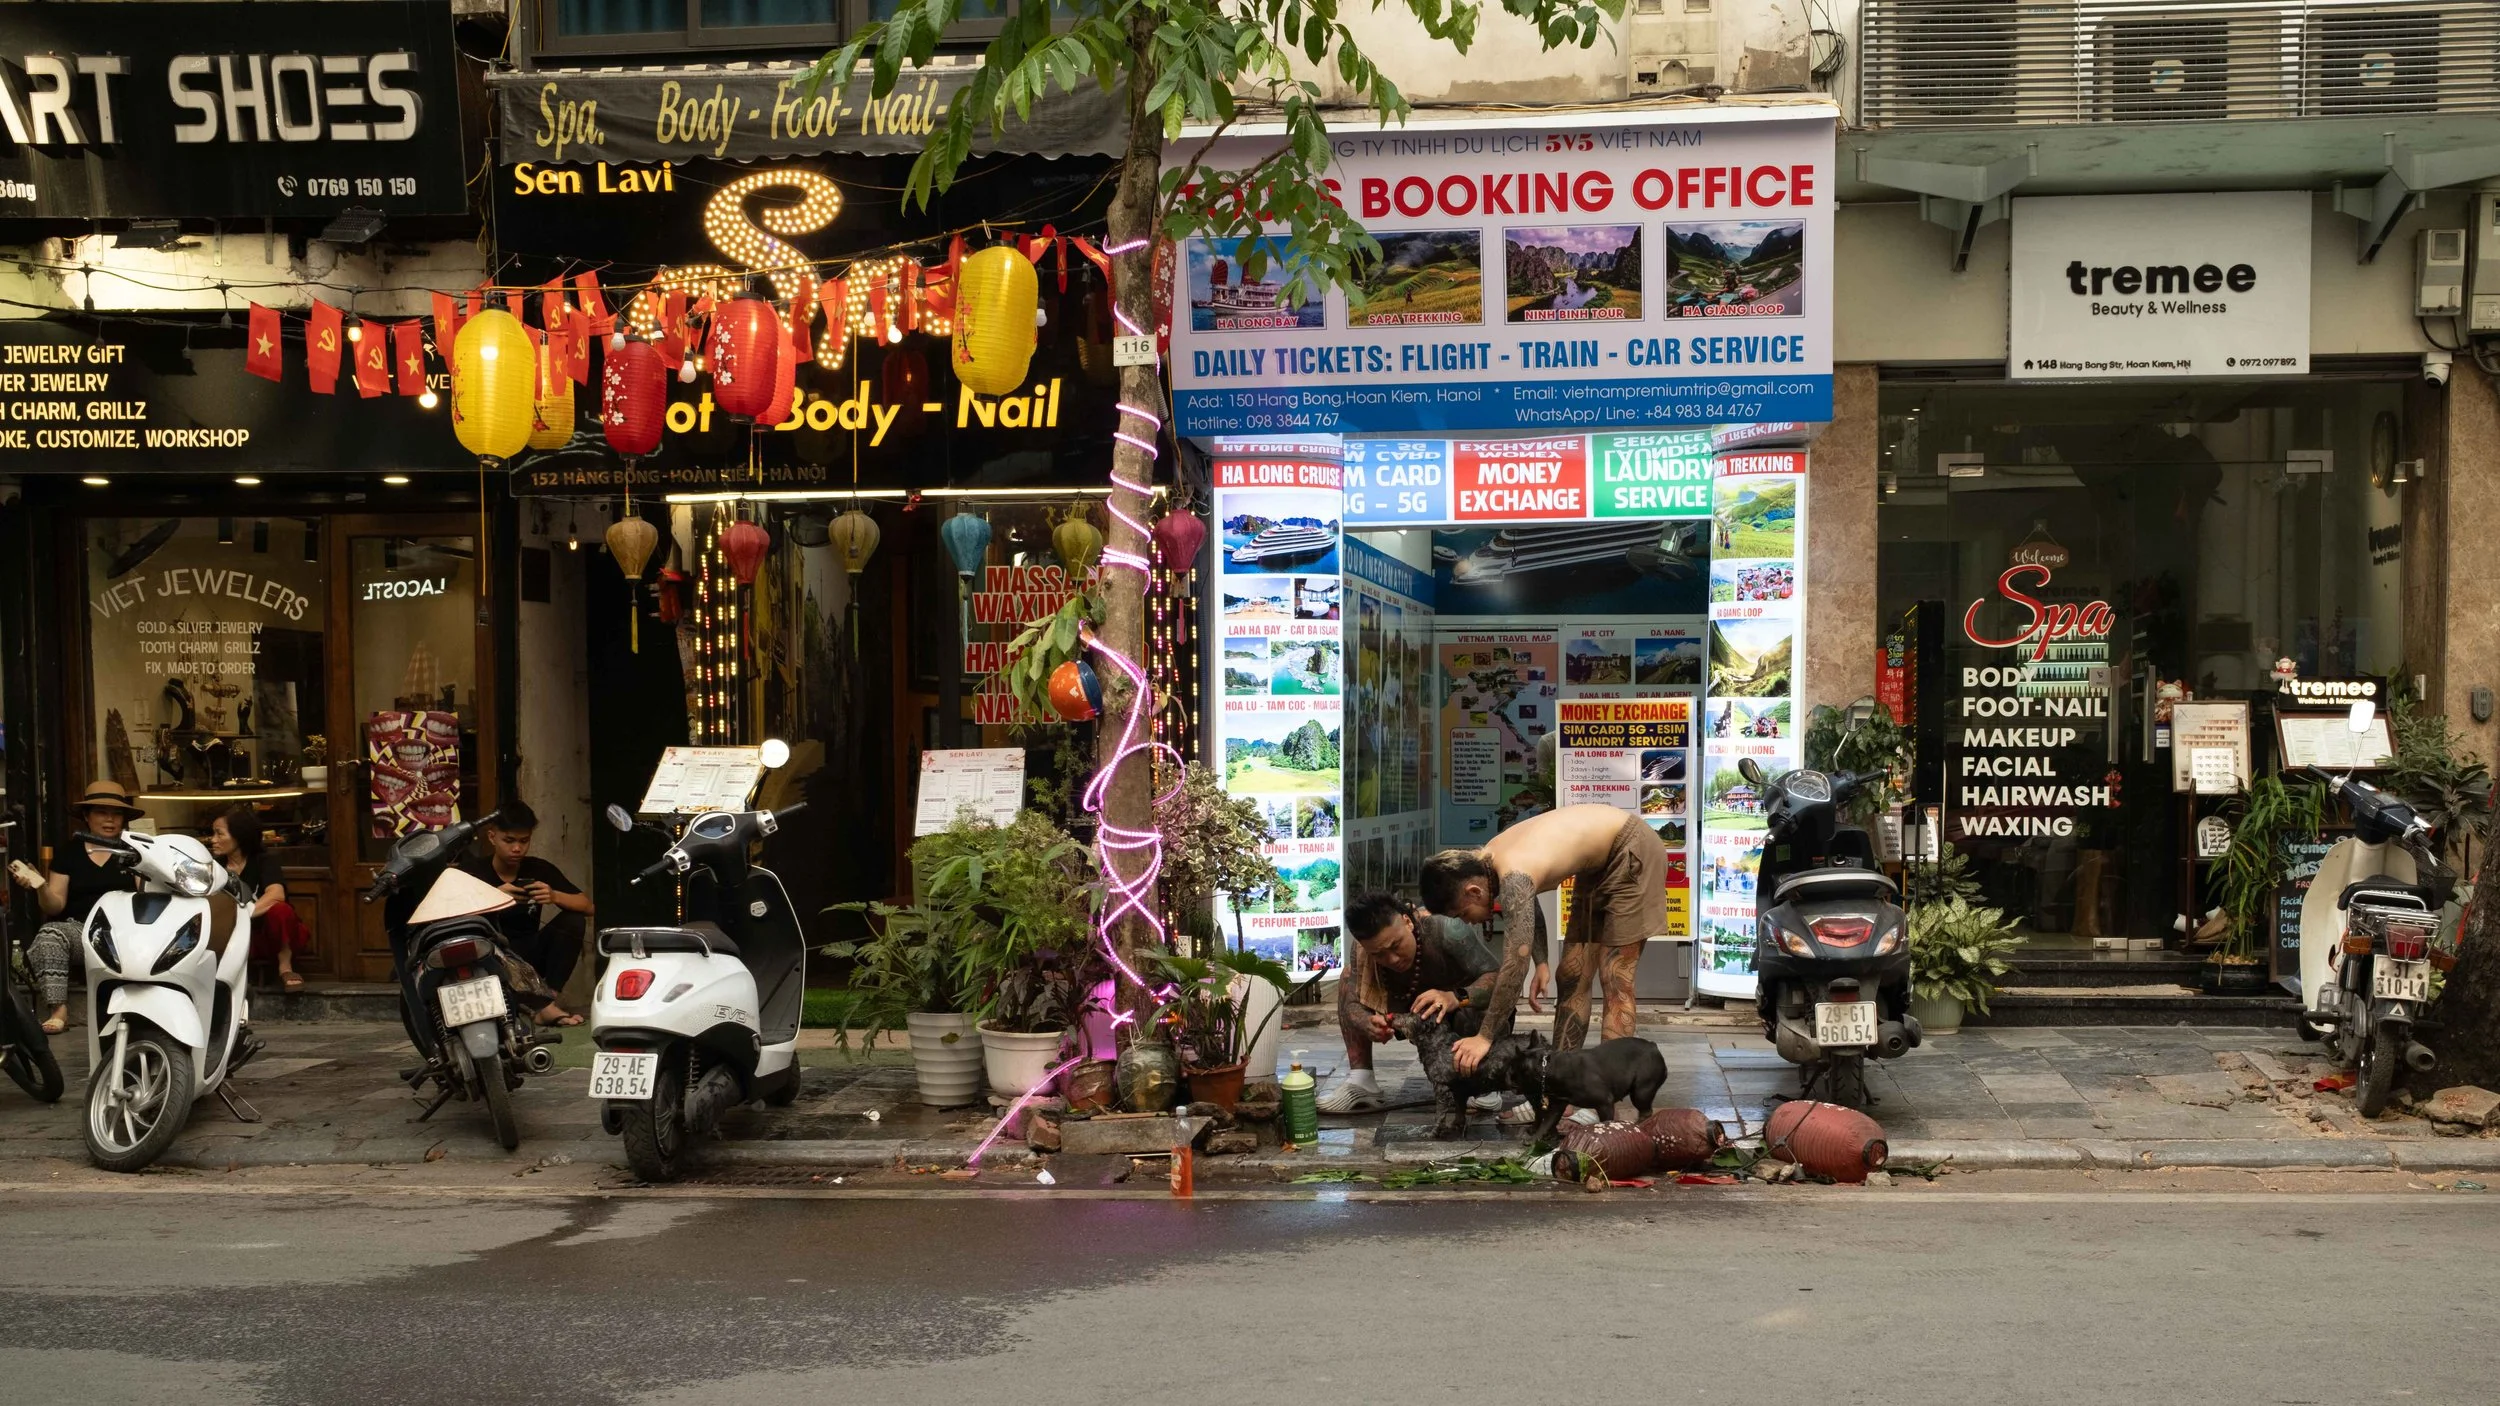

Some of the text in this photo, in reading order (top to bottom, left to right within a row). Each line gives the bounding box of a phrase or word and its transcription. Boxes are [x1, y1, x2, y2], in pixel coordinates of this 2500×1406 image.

[168, 53, 421, 143] SHOES
[657, 81, 740, 157] Body
[1362, 139, 1385, 156] TY
[1391, 137, 1447, 156] TNHH
[1454, 137, 1483, 154] DU
[1491, 134, 1539, 156] LỊCH
[1545, 132, 1594, 153] 5V5
[1600, 130, 1641, 152] VIỆT
[1650, 129, 1702, 148] NAM
[308, 177, 416, 196] 0769 150 150
[514, 161, 676, 195] Sen Lavi
[1361, 170, 1615, 219] BOOKING
[1632, 164, 1814, 211] OFFICE
[2066, 260, 2256, 296] tremee
[1368, 311, 1463, 325] SAPA TREKKING
[1524, 308, 1625, 321] NINH BINH TOUR
[1683, 303, 1785, 317] HA GIANG LOOP
[2092, 300, 2228, 317] Beauty & Wellness
[1217, 316, 1299, 329] HA LONG BAY
[4, 345, 82, 363] JEWELRY
[1122, 340, 1150, 353] 116
[1193, 335, 1804, 377] DAILY TICKETS: FLIGHT TRAIN CAR SERVICE
[2037, 360, 2057, 369] 148
[2059, 361, 2082, 371] Hang
[2085, 361, 2108, 371] Bong
[2109, 361, 2124, 370] Str,
[2126, 360, 2150, 369] Hoan
[2177, 359, 2191, 370] HN
[2239, 358, 2261, 368] 0972
[30, 373, 108, 392] JEWELRY
[1513, 381, 1815, 402] Email: vietnampremiumtrip@gmail.com
[956, 378, 1062, 428] Nail
[1187, 396, 1223, 409] Add:
[1230, 394, 1254, 408] 150
[1257, 393, 1299, 411] Hang
[1391, 389, 1431, 404] Kiem,
[1437, 388, 1482, 402] Hanoi
[11, 402, 82, 422] CHARM,
[86, 402, 147, 420] GRILLZ
[1606, 405, 1640, 420] Line:
[1645, 404, 1671, 419] +84
[1675, 404, 1702, 419] 983
[1706, 404, 1724, 418] 84
[1727, 403, 1763, 418] 4767
[1187, 412, 1340, 431] Hotline: 098 3844 767
[36, 429, 140, 449] CUSTOMIZE,
[145, 429, 250, 448] WORKSHOP
[531, 471, 558, 486] 152
[563, 467, 610, 485] HÀNG
[670, 465, 717, 482] HOÀN
[770, 464, 794, 481] HÀ
[797, 463, 828, 484] NỘI
[1477, 462, 1562, 485] MONEY
[1604, 459, 1713, 482] LAUNDRY
[1730, 456, 1794, 474] TREKKING
[1222, 464, 1341, 487] HA LONG CRUISE
[1375, 465, 1442, 488] CARD
[1397, 491, 1428, 514] 5G
[1460, 489, 1581, 513] EXCHANGE
[1615, 485, 1707, 509] SERVICE
[2012, 549, 2065, 565] Welcome
[90, 568, 310, 621] VIET JEWELERS
[1963, 563, 2116, 663] Spa
[137, 621, 264, 635] GOLD SILVER JEWELRY
[1228, 625, 1246, 636] LAN
[1249, 625, 1262, 635] HA
[1263, 625, 1282, 636] BAY
[1290, 625, 1305, 635] CAT
[1307, 625, 1318, 635] BA
[1599, 629, 1615, 637] CITY
[1651, 629, 1662, 637] DA
[139, 641, 261, 654] TOOTH CHARM GRILLZ
[1457, 634, 1552, 643] VIETNAM TRAVEL MAP
[167, 661, 199, 675] MADE
[201, 662, 216, 675] TO
[218, 661, 256, 675] ORDER
[1962, 667, 2036, 687] BODY
[2290, 679, 2377, 696] tremee
[1225, 700, 1306, 711] HOA LU TAM COC
[1561, 703, 1687, 721] MONEY EXCHANGE
[1962, 697, 2108, 717] FOOT-NAIL
[1563, 724, 1685, 734] SIM CARD 5G ESIM
[1963, 728, 2077, 748] MAKEUP
[1570, 736, 1680, 747] LAUNDRY SERVICE
[1962, 757, 2057, 776] FACIAL
[1592, 784, 1630, 792] TREKKING
[1961, 786, 2110, 806] HAIRWASH
[1960, 816, 2074, 837] WAXING
[1252, 916, 1329, 928] PERFUME PAGODA
[2280, 909, 2299, 919] Hair
[1825, 1006, 1867, 1024] 29-G1
[1820, 1024, 1873, 1043] 960.54
[602, 1057, 648, 1076] 29-AE
[594, 1077, 649, 1097] 638.54
